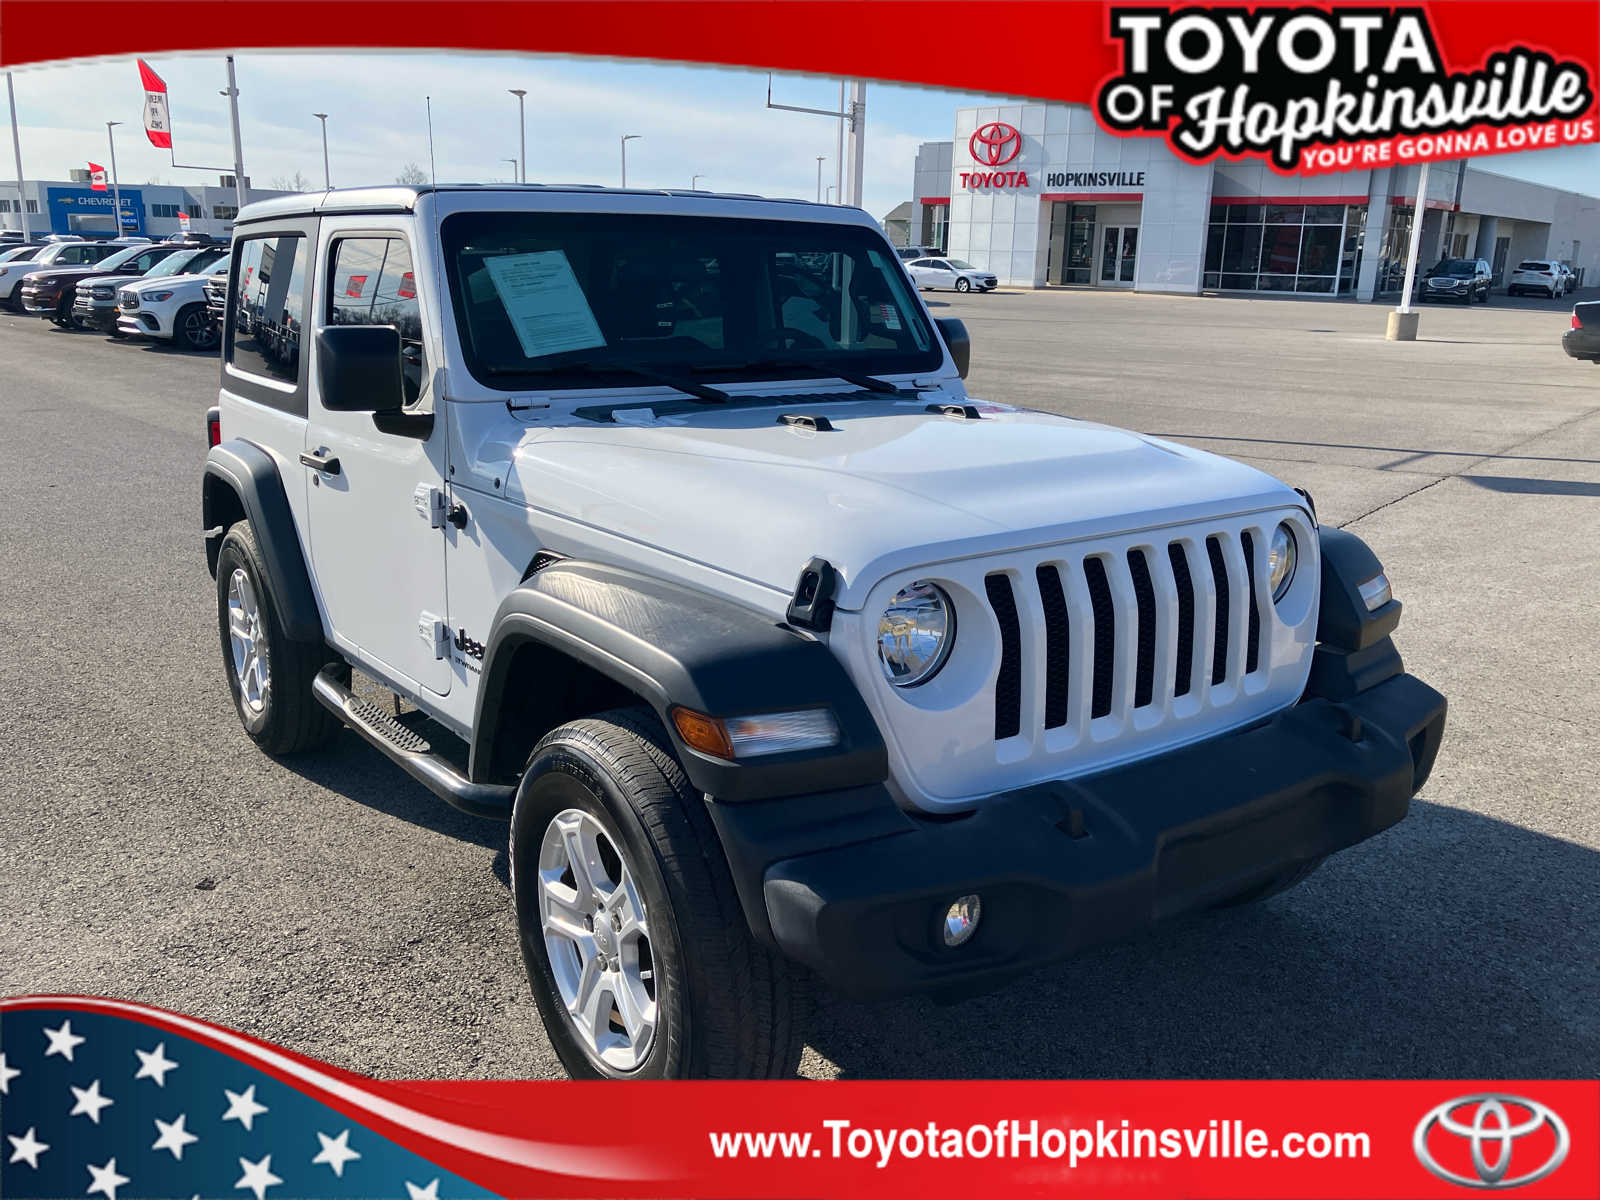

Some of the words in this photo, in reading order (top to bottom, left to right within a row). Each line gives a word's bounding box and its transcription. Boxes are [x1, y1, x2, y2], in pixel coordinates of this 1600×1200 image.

[960, 171, 1029, 189] TOYOTA
[1047, 172, 1145, 187] HOPKINSVILLE
[78, 197, 132, 207] CHEVROET
